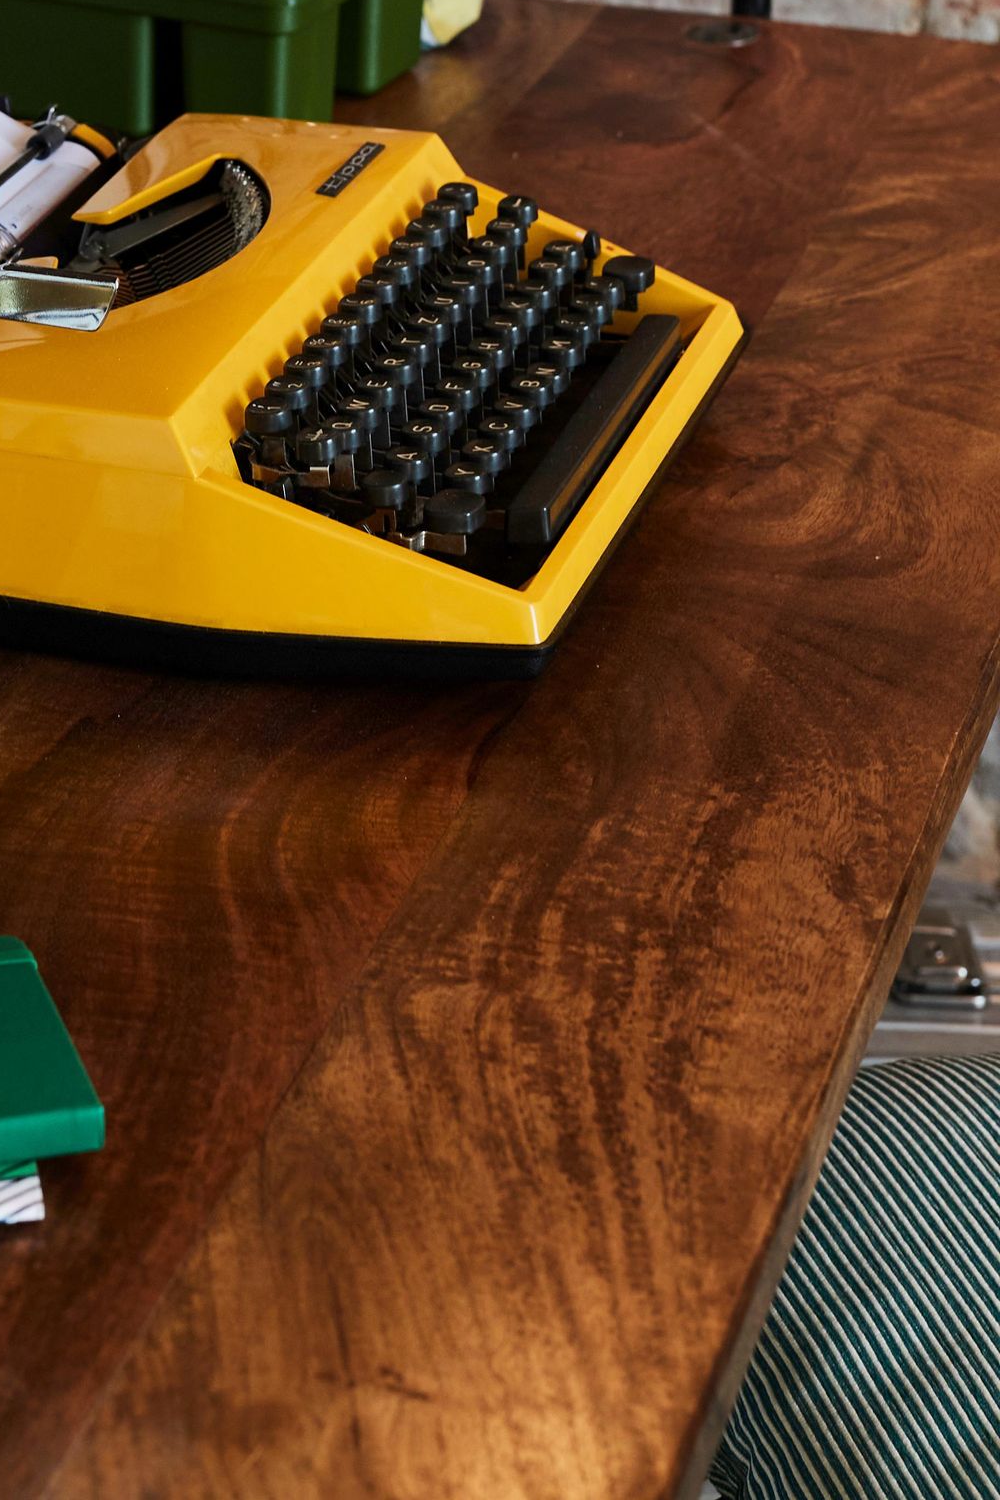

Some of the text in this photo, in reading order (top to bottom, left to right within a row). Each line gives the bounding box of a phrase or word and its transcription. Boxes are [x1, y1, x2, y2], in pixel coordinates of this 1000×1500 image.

[322, 143, 379, 192] tippa
[332, 422, 353, 430] Q
[346, 399, 370, 409] W
[366, 380, 388, 388] E
[383, 358, 405, 367] R
[418, 316, 439, 324] Z
[434, 296, 454, 305] U
[467, 260, 486, 268] O
[396, 452, 418, 460] A
[412, 425, 433, 434] S
[428, 404, 450, 412] D
[445, 382, 464, 390] F
[462, 361, 482, 369] G
[479, 342, 500, 350] H
[454, 467, 475, 476] Y
[472, 445, 494, 453] X
[488, 422, 509, 431] C
[503, 401, 524, 409] V
[519, 380, 540, 388] B
[549, 340, 572, 349] M
